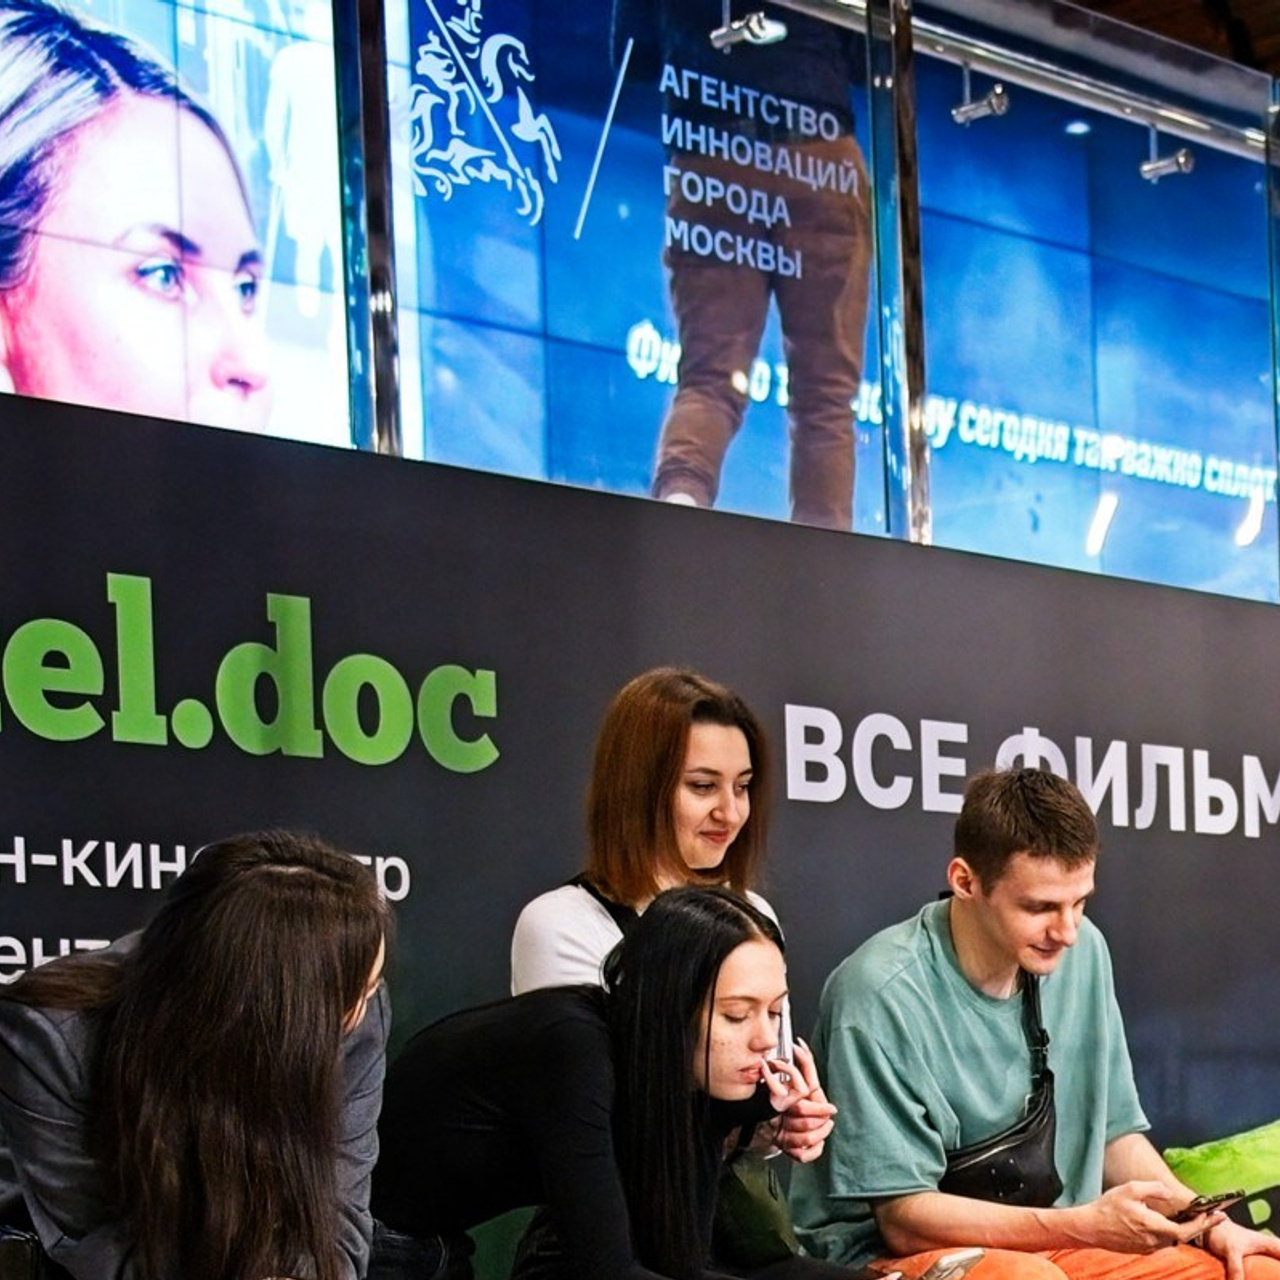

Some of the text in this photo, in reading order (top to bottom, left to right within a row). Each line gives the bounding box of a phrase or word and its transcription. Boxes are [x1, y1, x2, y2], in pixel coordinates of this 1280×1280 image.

[659, 64, 839, 142] АГЕНТСТВО
[661, 113, 859, 197] ИННОВАЦИЙ
[663, 165, 791, 228] ГОРОДА
[665, 216, 802, 279] МОСКВЫ
[957, 400, 1070, 463] сегодня
[1121, 439, 1203, 489] важно
[0, 572, 500, 773] el.doc
[784, 703, 968, 813] ВСЕ
